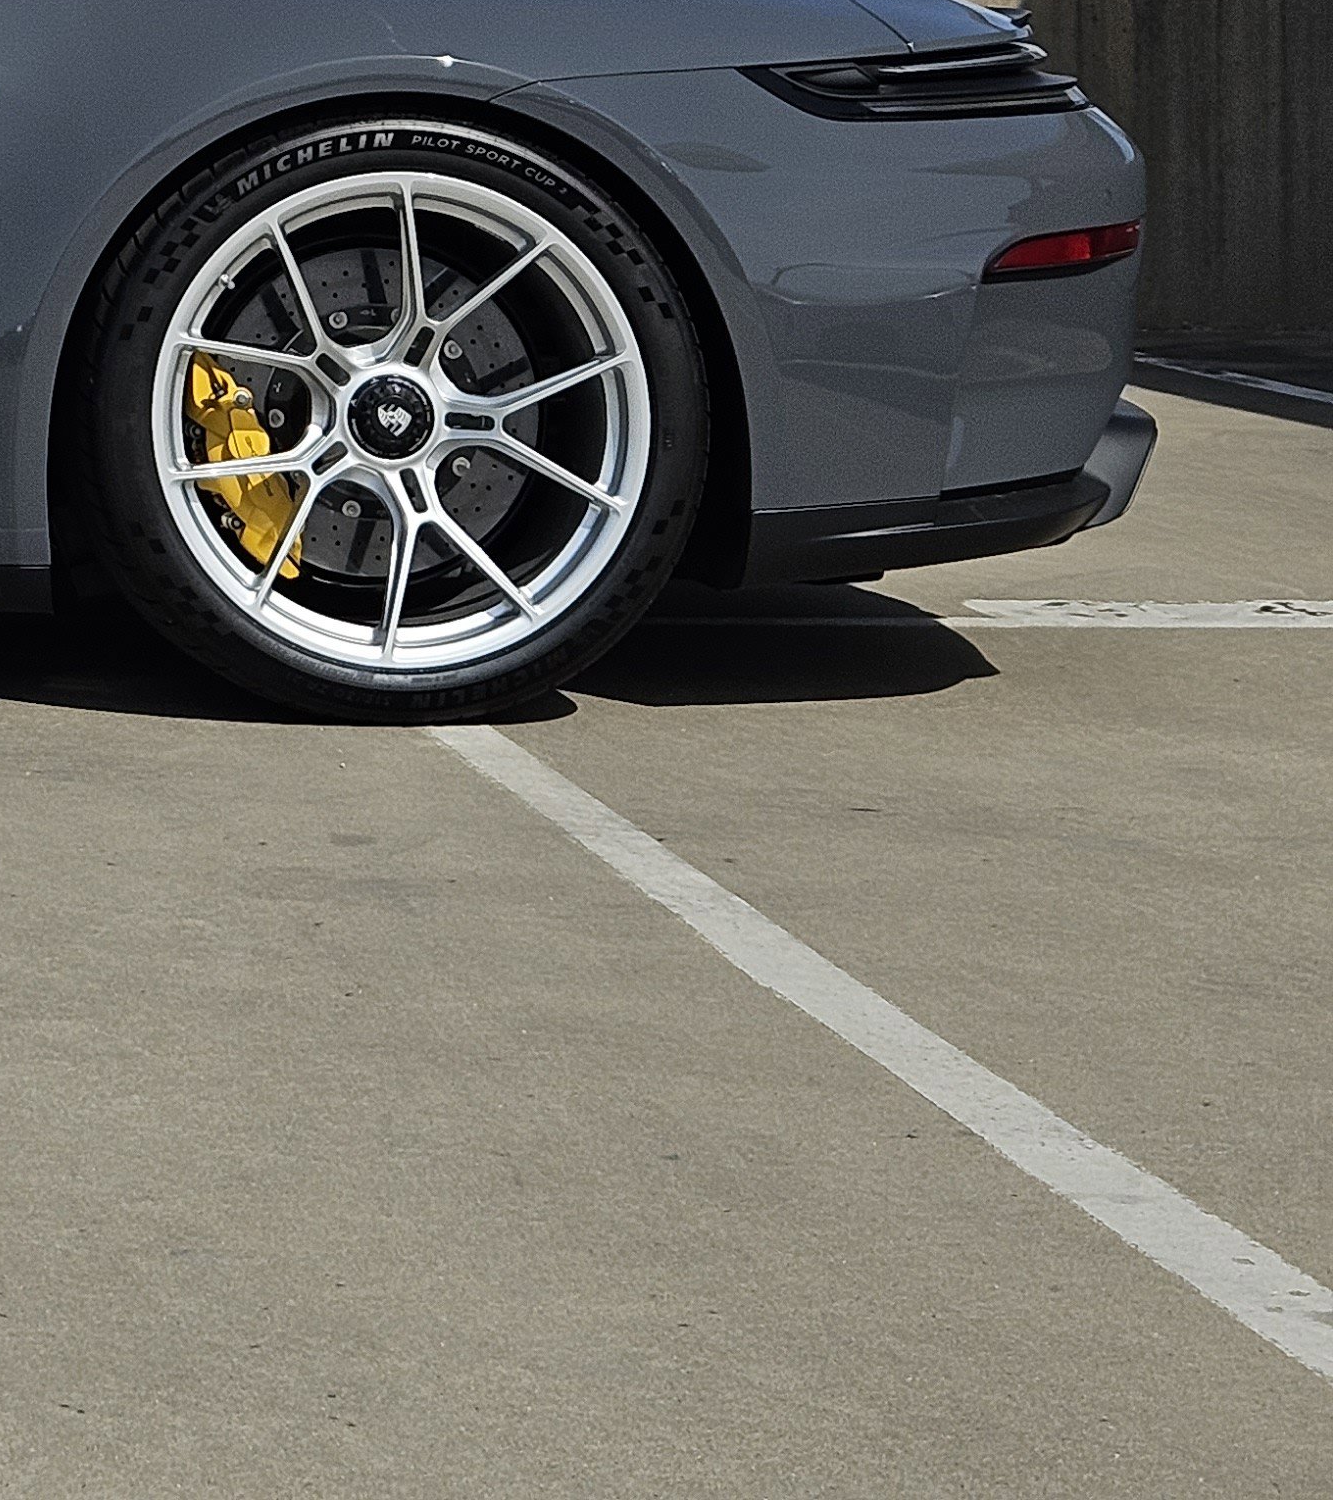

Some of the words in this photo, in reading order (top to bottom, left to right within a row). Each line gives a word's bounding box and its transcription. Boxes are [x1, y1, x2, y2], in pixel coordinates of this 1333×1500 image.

[236, 132, 394, 196] MICHELIN
[412, 135, 458, 150] PILOT
[465, 143, 521, 171] SPORT
[524, 166, 556, 188] CUP
